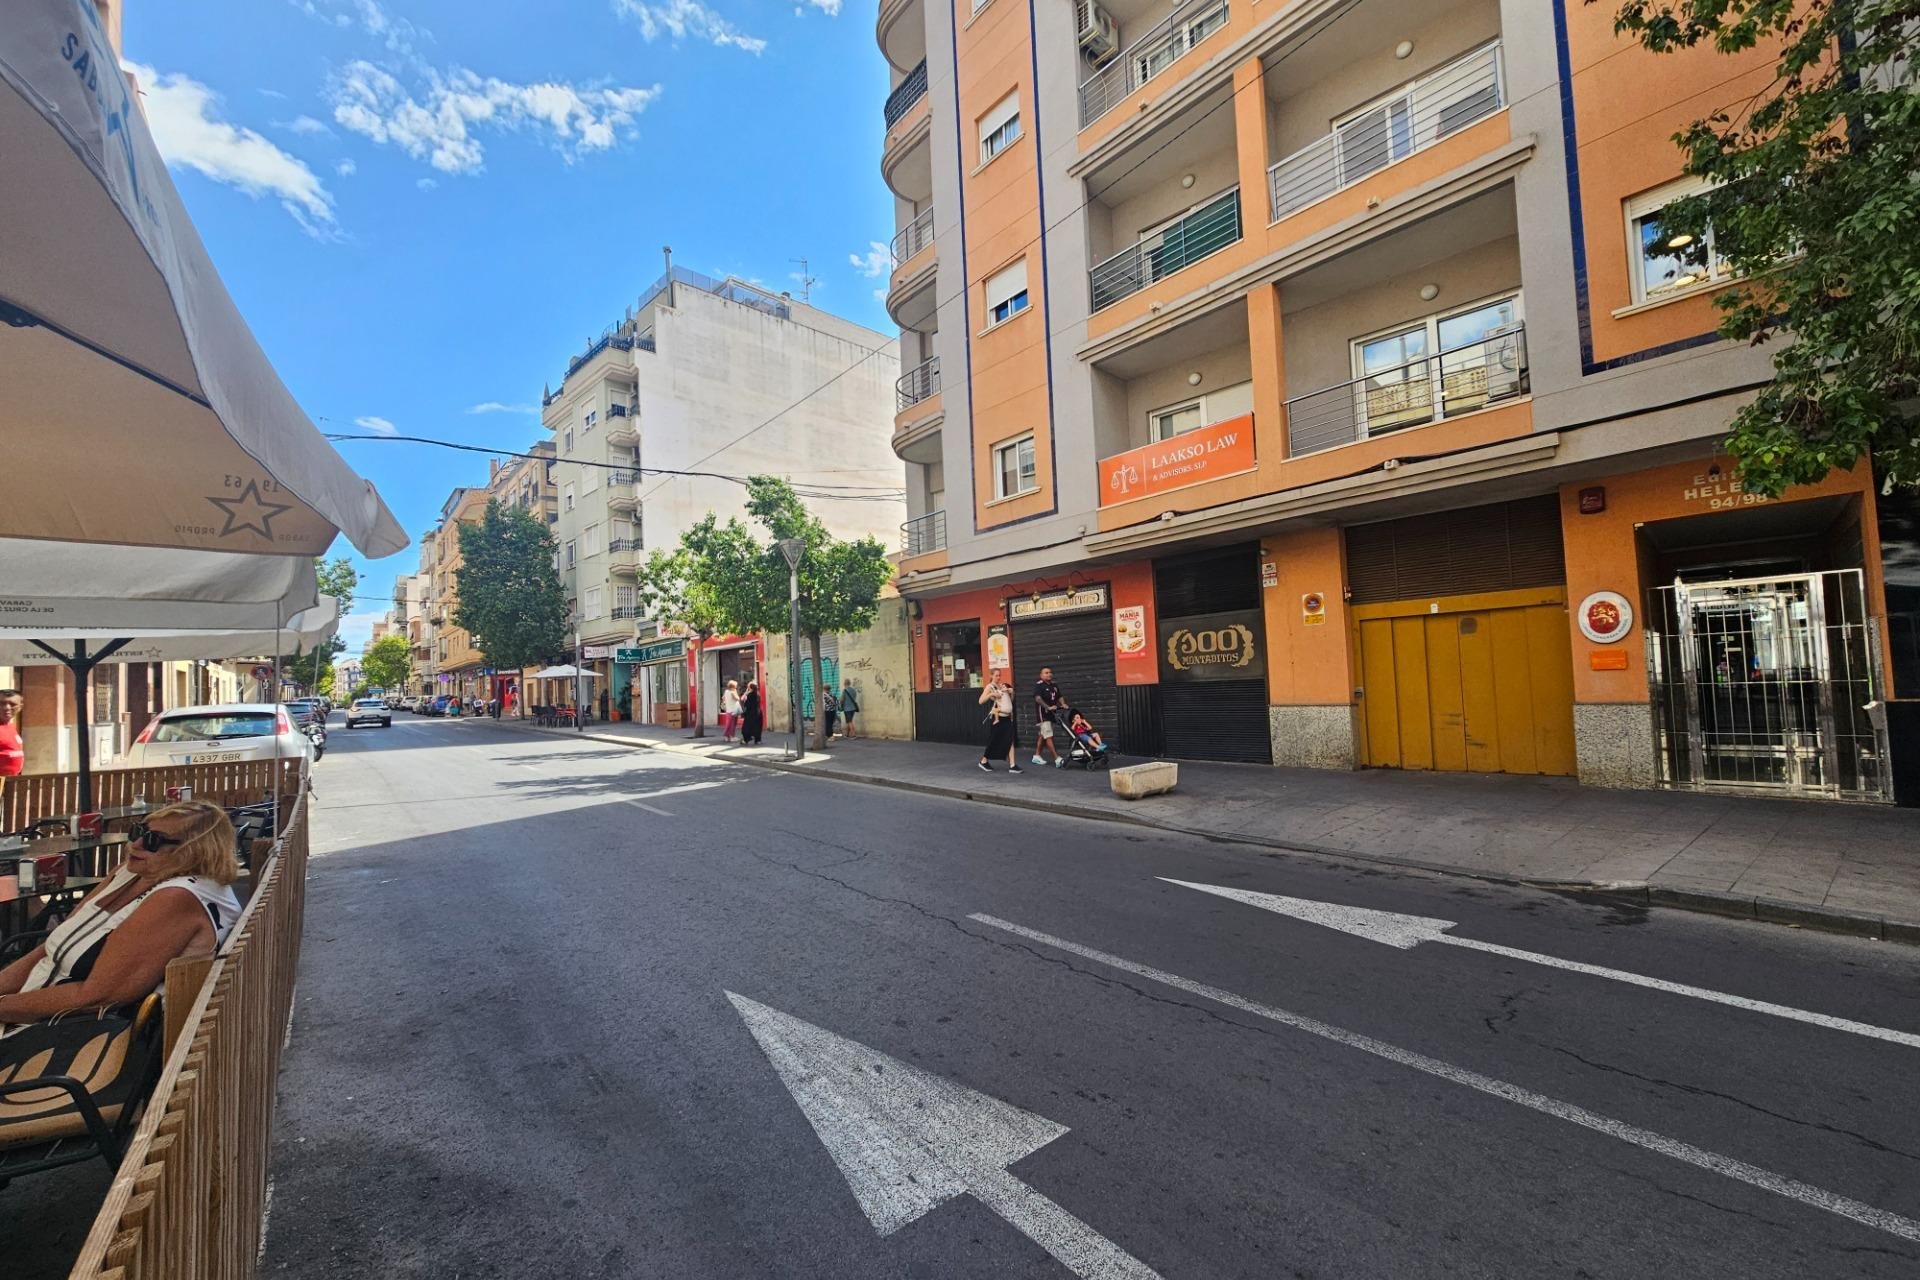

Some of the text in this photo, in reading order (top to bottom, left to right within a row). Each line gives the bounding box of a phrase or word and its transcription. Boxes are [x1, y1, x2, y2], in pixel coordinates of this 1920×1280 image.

[61, 32, 99, 92] SAB
[1152, 432, 1238, 469] LAAKSO LAW
[1684, 481, 1742, 501] HELE
[1181, 652, 1239, 665] MONTADITOS
[192, 754, 219, 763] 4337
